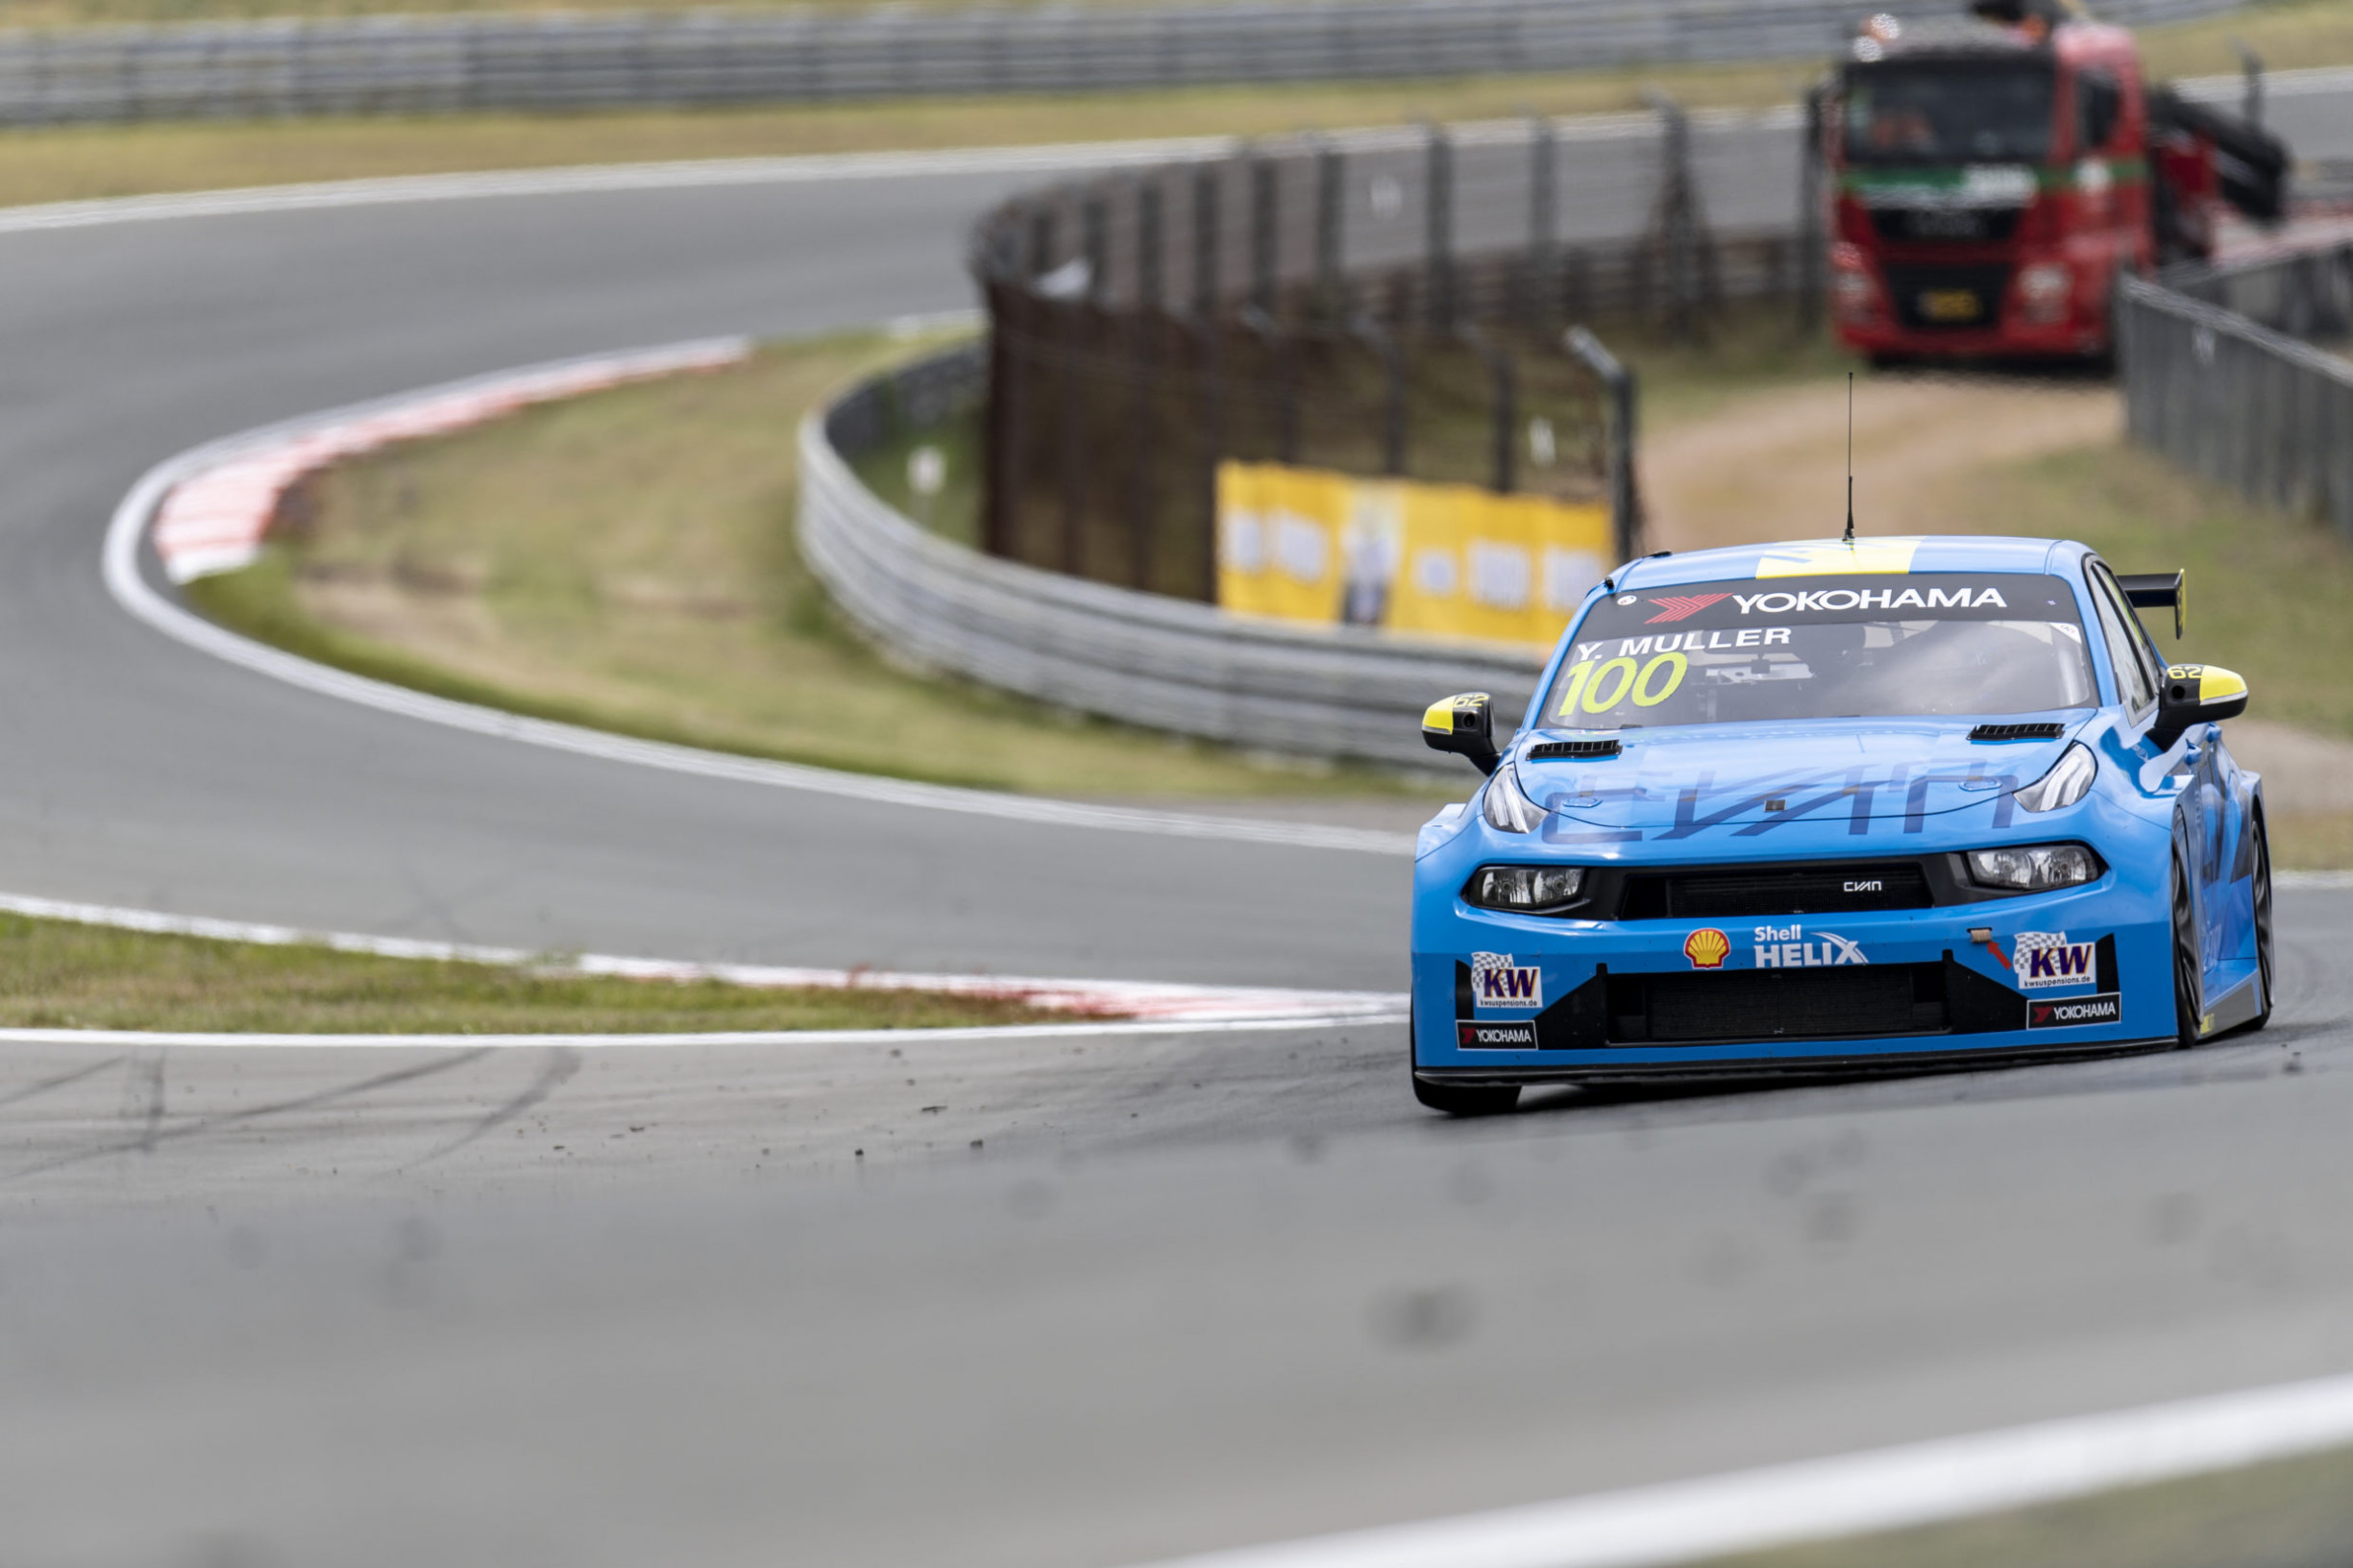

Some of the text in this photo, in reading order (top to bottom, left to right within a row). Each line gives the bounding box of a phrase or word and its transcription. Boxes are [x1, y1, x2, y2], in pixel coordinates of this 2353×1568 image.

[1731, 587, 2007, 614] YOKOHAMA
[1578, 627, 1792, 661] Y. MULLER
[2167, 666, 2202, 679] 62
[1557, 651, 1688, 717] 100
[1453, 694, 1489, 708] 62
[1753, 924, 1802, 942] Shell
[1753, 936, 1869, 968] HELIX
[2029, 944, 2093, 978] KW
[1483, 968, 1538, 998] KW
[2024, 976, 2091, 987] kwsuspensions.de
[1480, 999, 1537, 1008] kwsuspensions.de
[2053, 1002, 2116, 1019] YOKOHAMA
[1476, 1029, 1532, 1042] YOKOHAMA
